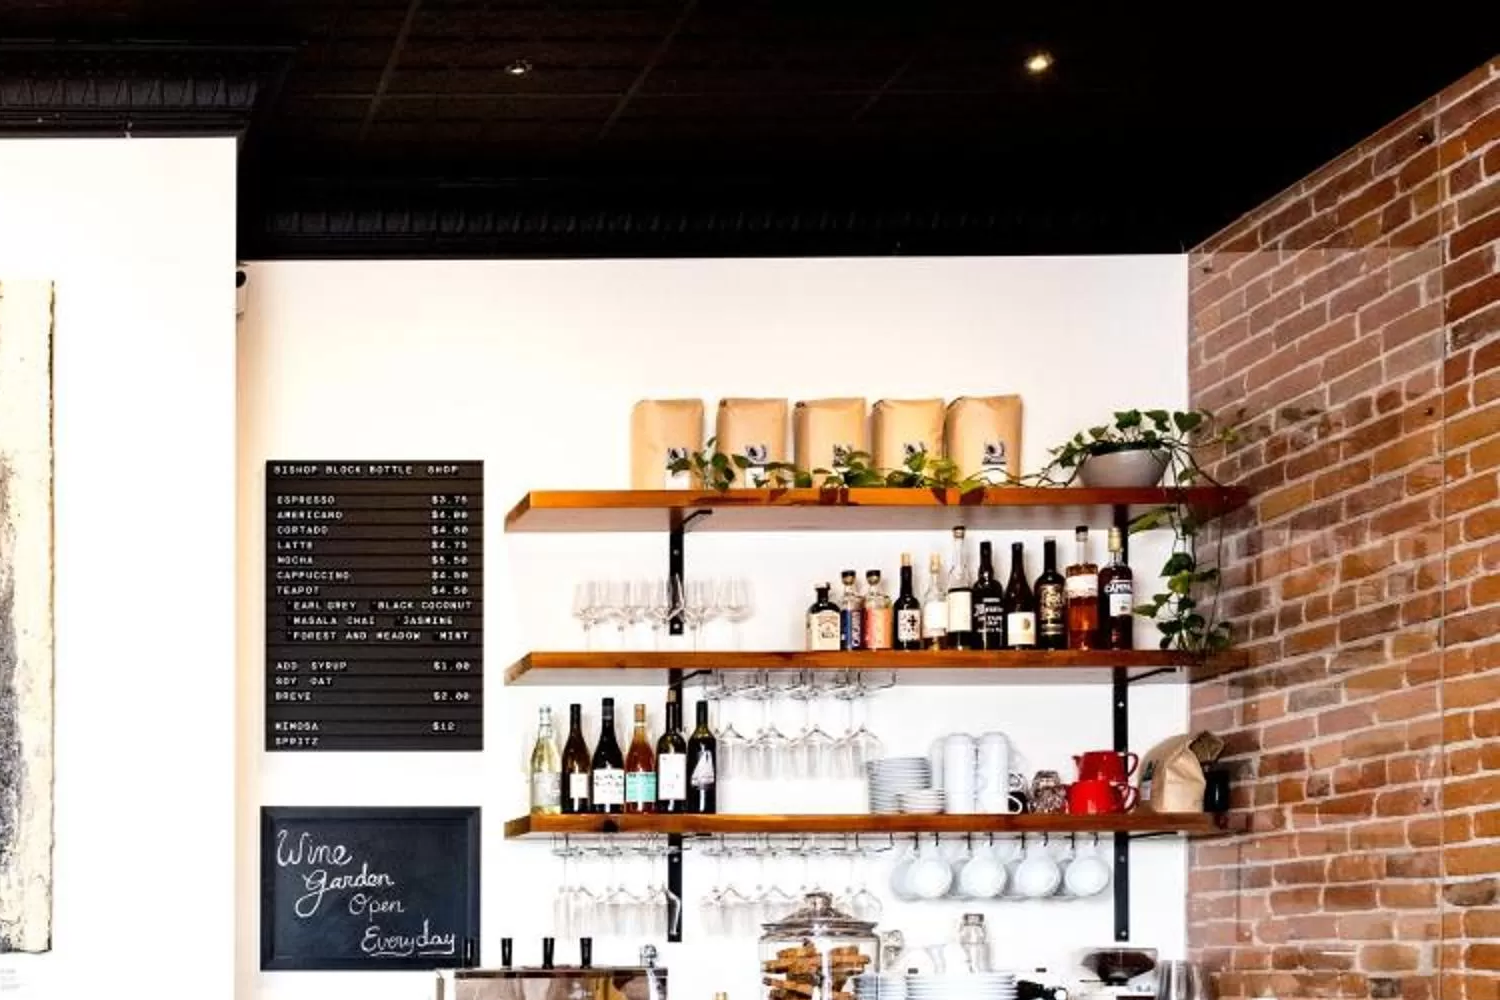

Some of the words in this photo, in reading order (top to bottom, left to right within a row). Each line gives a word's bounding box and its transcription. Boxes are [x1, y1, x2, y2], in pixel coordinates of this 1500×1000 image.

[273, 466, 318, 475] BISHOP
[325, 466, 361, 475] BLOCK
[369, 466, 413, 475] BOTTLE
[427, 466, 459, 475] SHOP
[276, 495, 335, 504] ESPRESSO
[276, 511, 343, 519] AMERICANO
[276, 526, 329, 534] CORTADO
[276, 541, 313, 549] LATTE
[276, 556, 313, 564] MOCHA
[276, 571, 351, 580] CAPPUCCINO
[276, 586, 319, 595] TEAPOT
[327, 601, 357, 610] GREY
[421, 601, 473, 609] COCONUT
[346, 616, 375, 624] CHAI
[345, 631, 367, 640] AND
[376, 631, 421, 640] MEADOW
[275, 661, 298, 670] ADD
[311, 661, 347, 670] SYRUP
[275, 677, 297, 685] SOY
[309, 677, 332, 685] OAT
[275, 721, 319, 730] MIMOSA
[275, 737, 319, 745] SPRITZ
[276, 829, 353, 867] Wine
[349, 893, 405, 922] Open
[361, 918, 456, 957] Everyday
